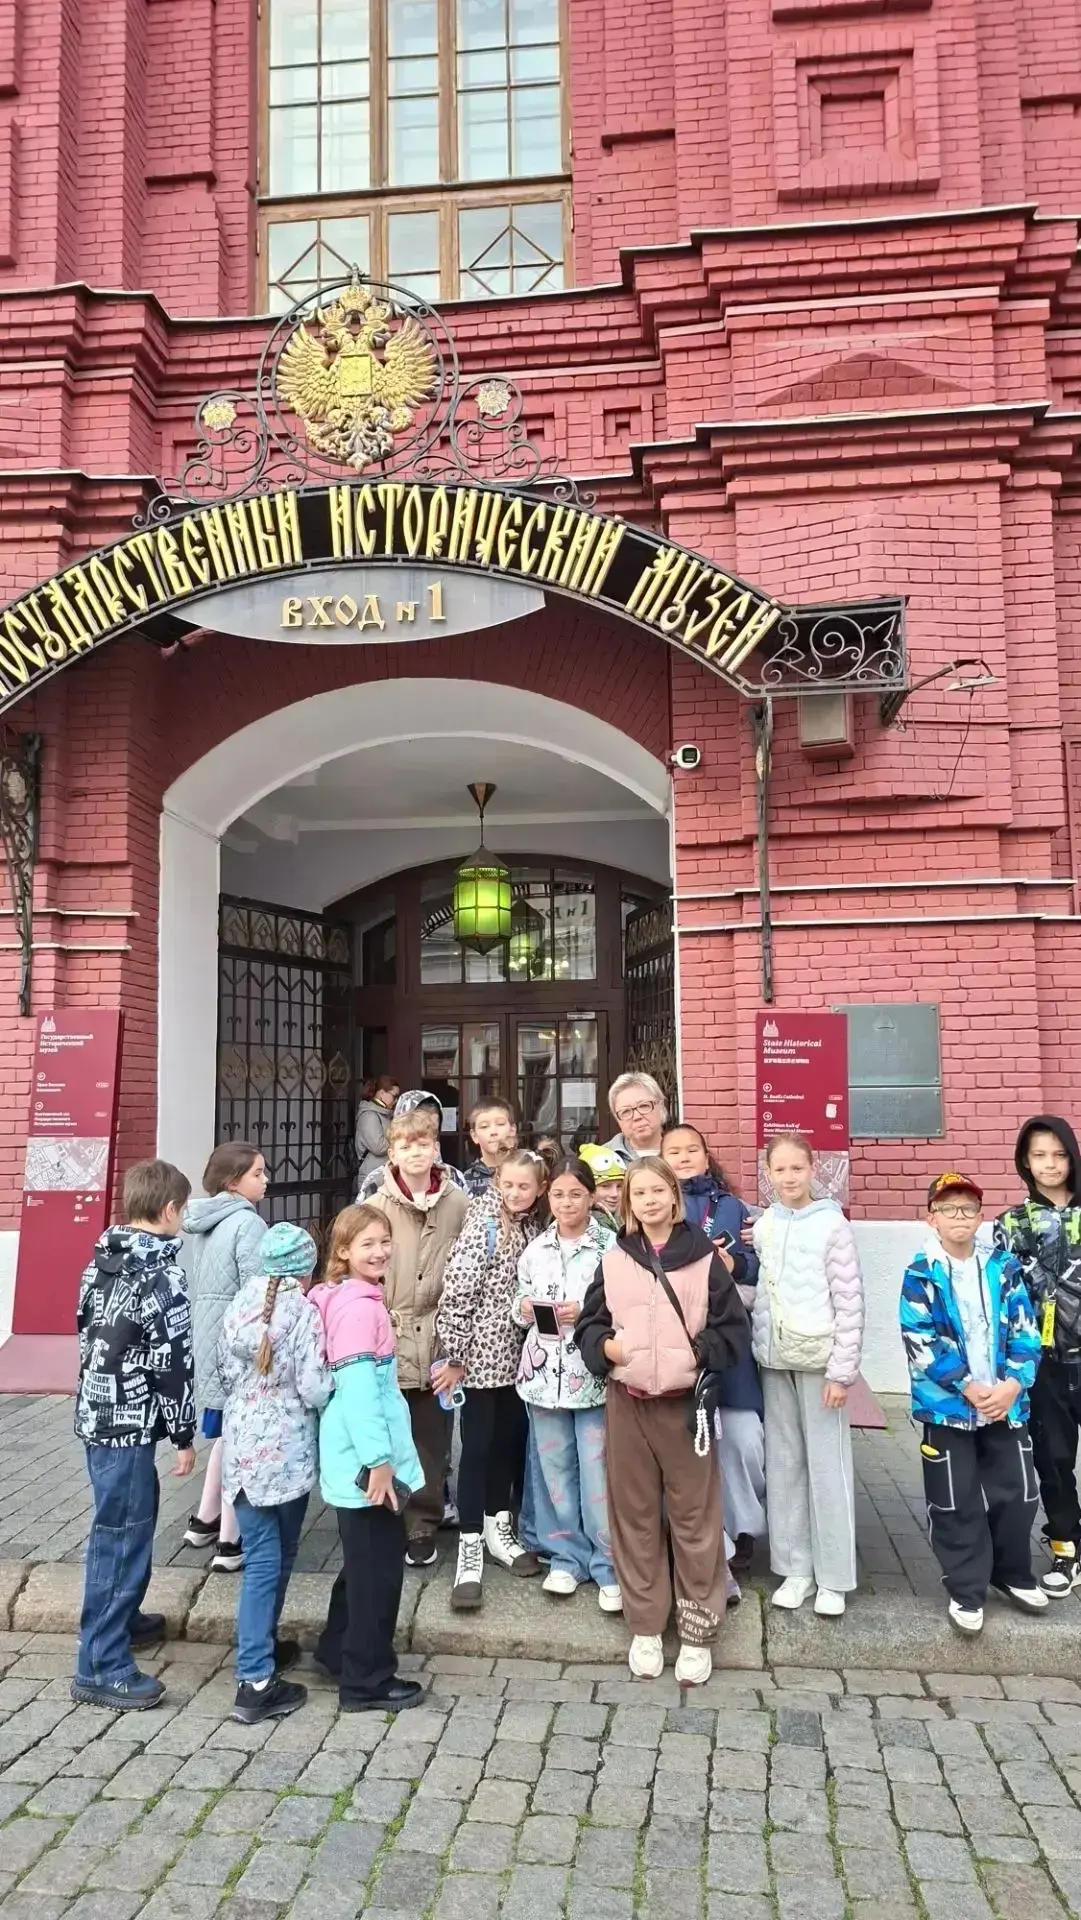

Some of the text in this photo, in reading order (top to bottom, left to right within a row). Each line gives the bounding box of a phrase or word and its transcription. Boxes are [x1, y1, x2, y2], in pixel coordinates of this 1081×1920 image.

[0, 484, 782, 698] ОСУДАРСТВЕННЫЙ ИСТОРИЧЕСКИЙ МУЗЕЙ
[427, 580, 447, 621] 1
[763, 1039, 822, 1047] State Historical
[763, 1047, 796, 1055] Museum
